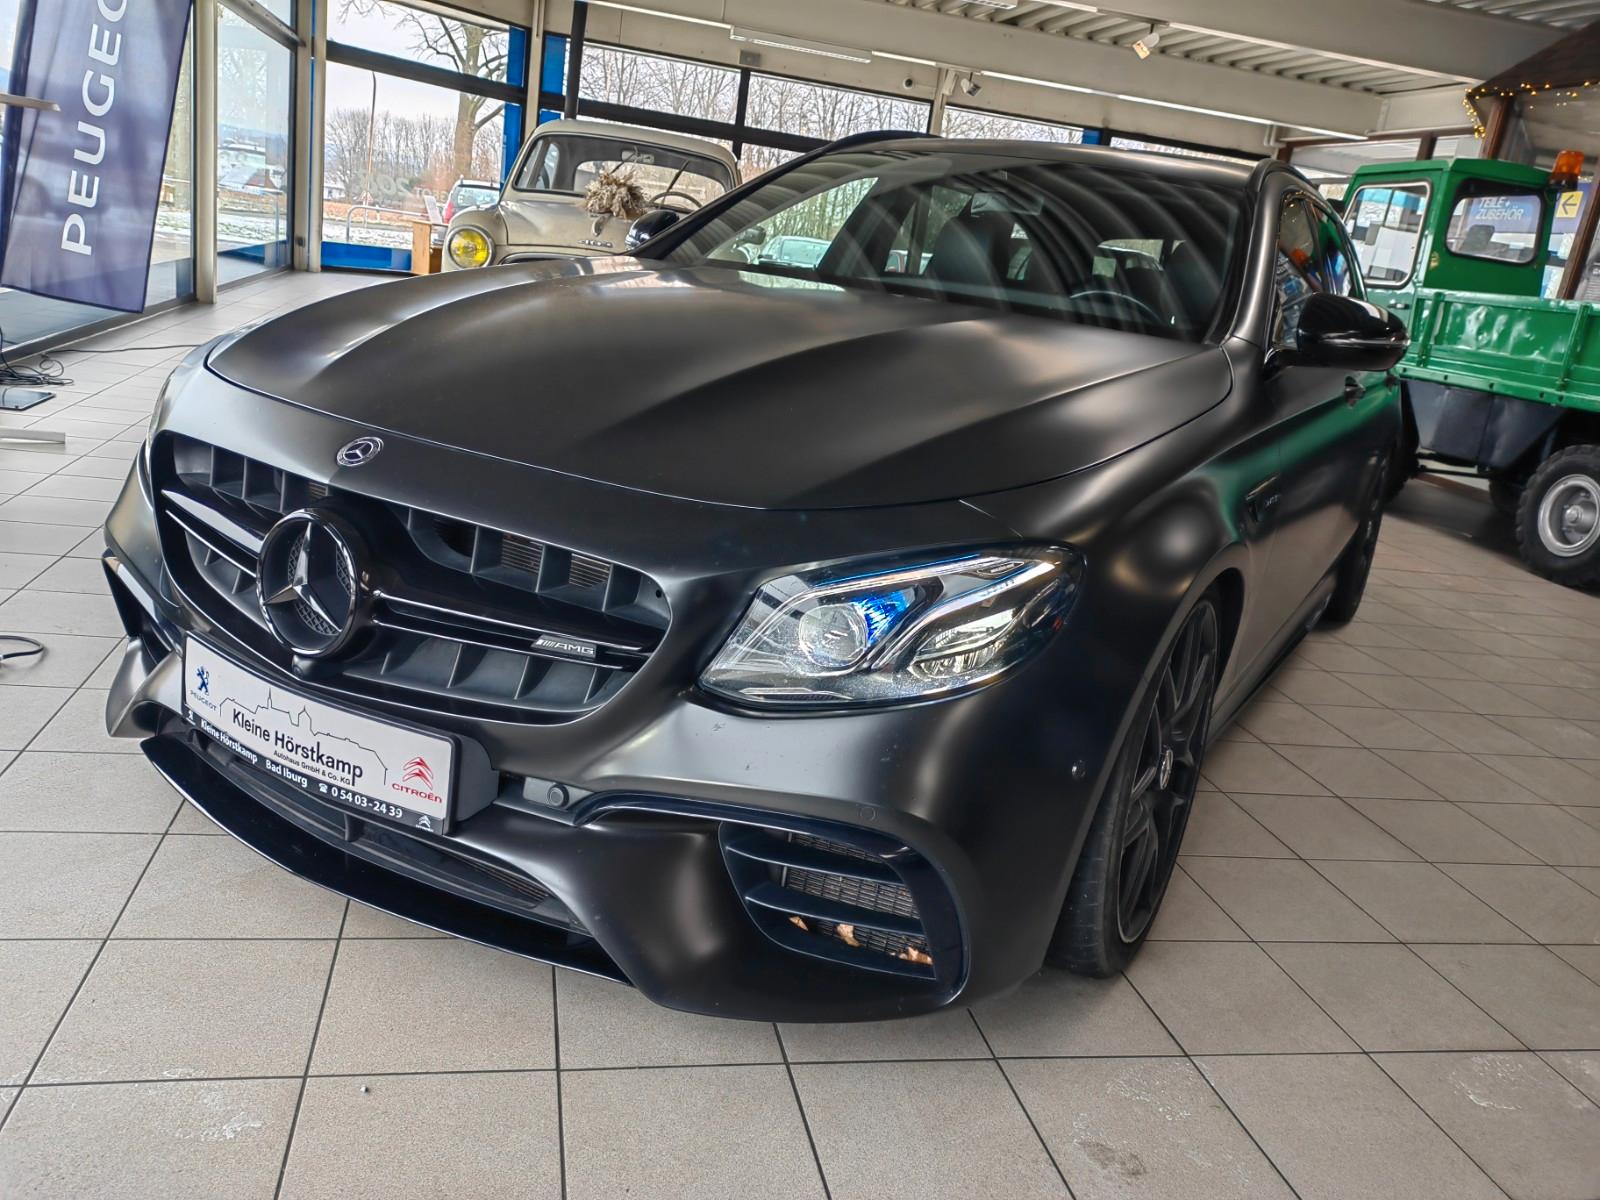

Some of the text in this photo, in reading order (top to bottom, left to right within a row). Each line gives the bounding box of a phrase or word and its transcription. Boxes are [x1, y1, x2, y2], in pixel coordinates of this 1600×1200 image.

[553, 641, 594, 655] AMG
[201, 719, 220, 739] Kleine
[220, 732, 258, 765] Hörstkamp
[265, 759, 282, 775] Bad
[283, 767, 308, 788] Iburg
[232, 708, 364, 787] Kleine Hörstkamp
[273, 750, 300, 767] Autohaus
[301, 761, 320, 774] GmbH
[327, 771, 339, 781] Co.
[340, 776, 351, 785] KG
[391, 782, 443, 803] CITROËN
